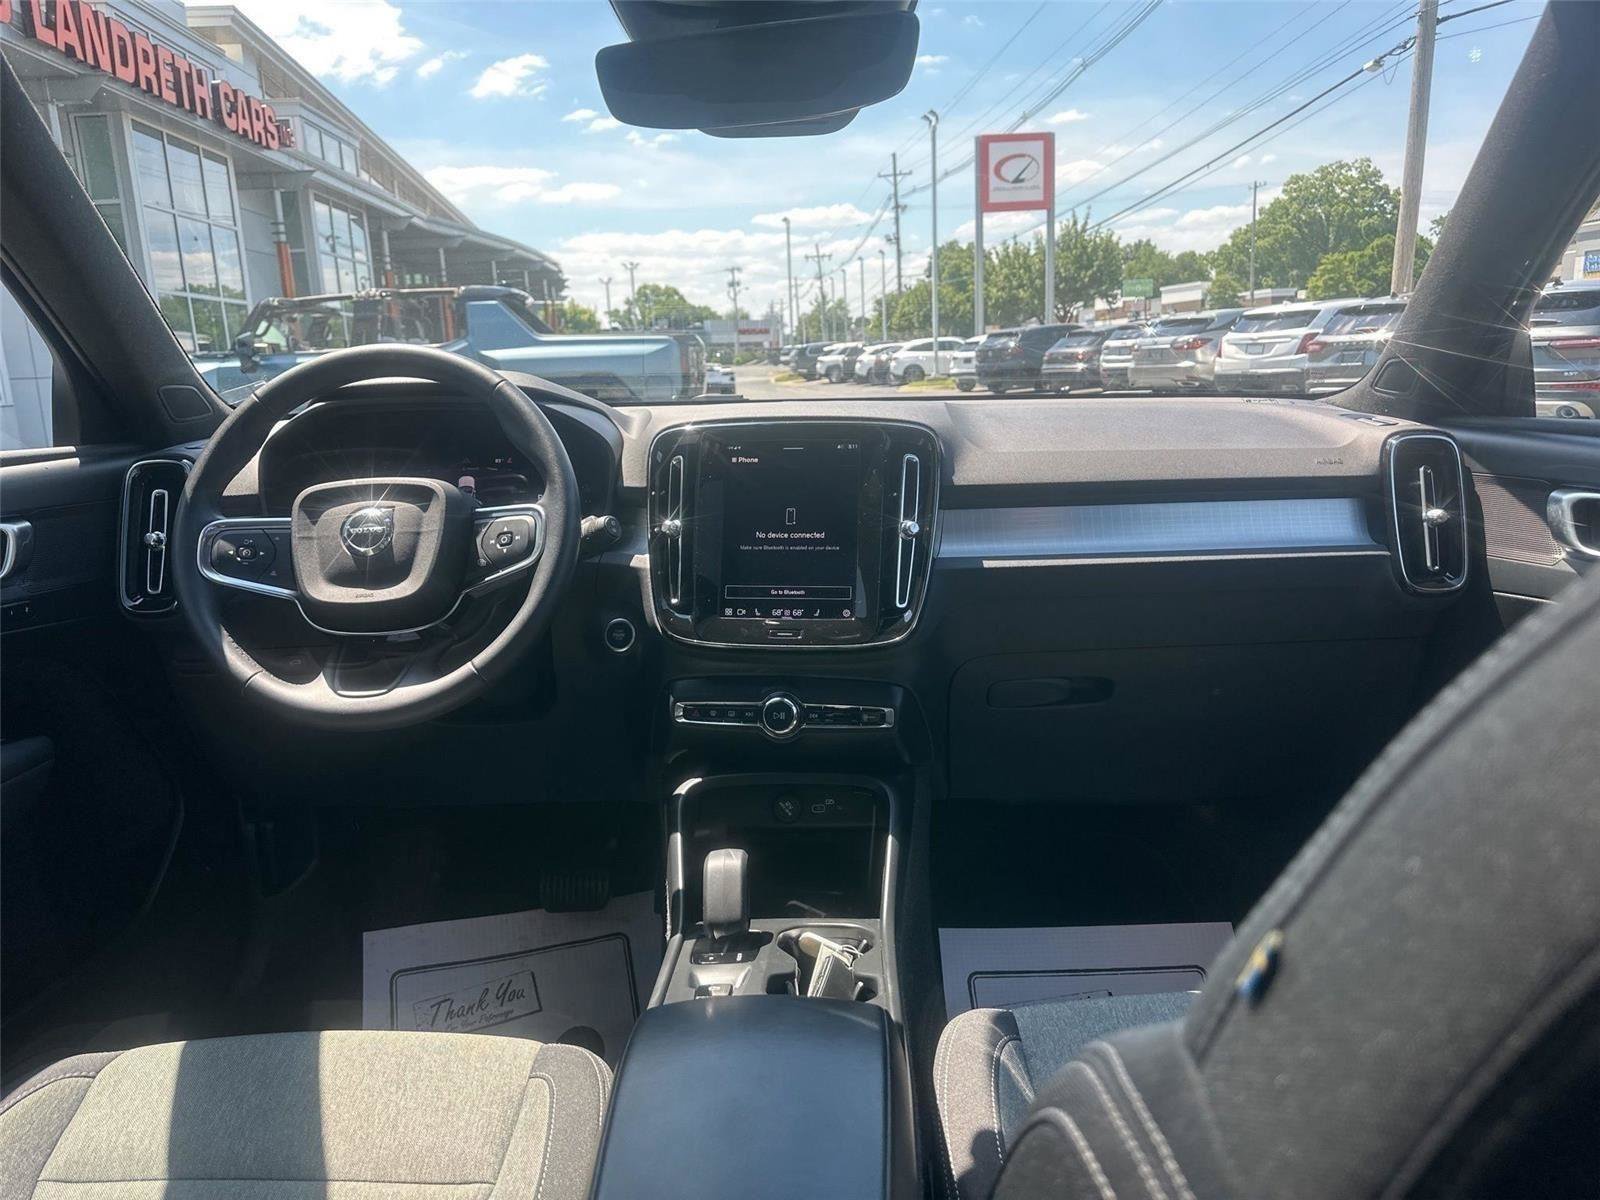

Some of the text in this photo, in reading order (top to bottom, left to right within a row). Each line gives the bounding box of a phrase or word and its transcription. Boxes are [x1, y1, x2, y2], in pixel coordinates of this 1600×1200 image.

[31, 0, 280, 149] LANDRETH CARS
[756, 531, 825, 539] No device connected
[430, 979, 526, 1027] Thank You
